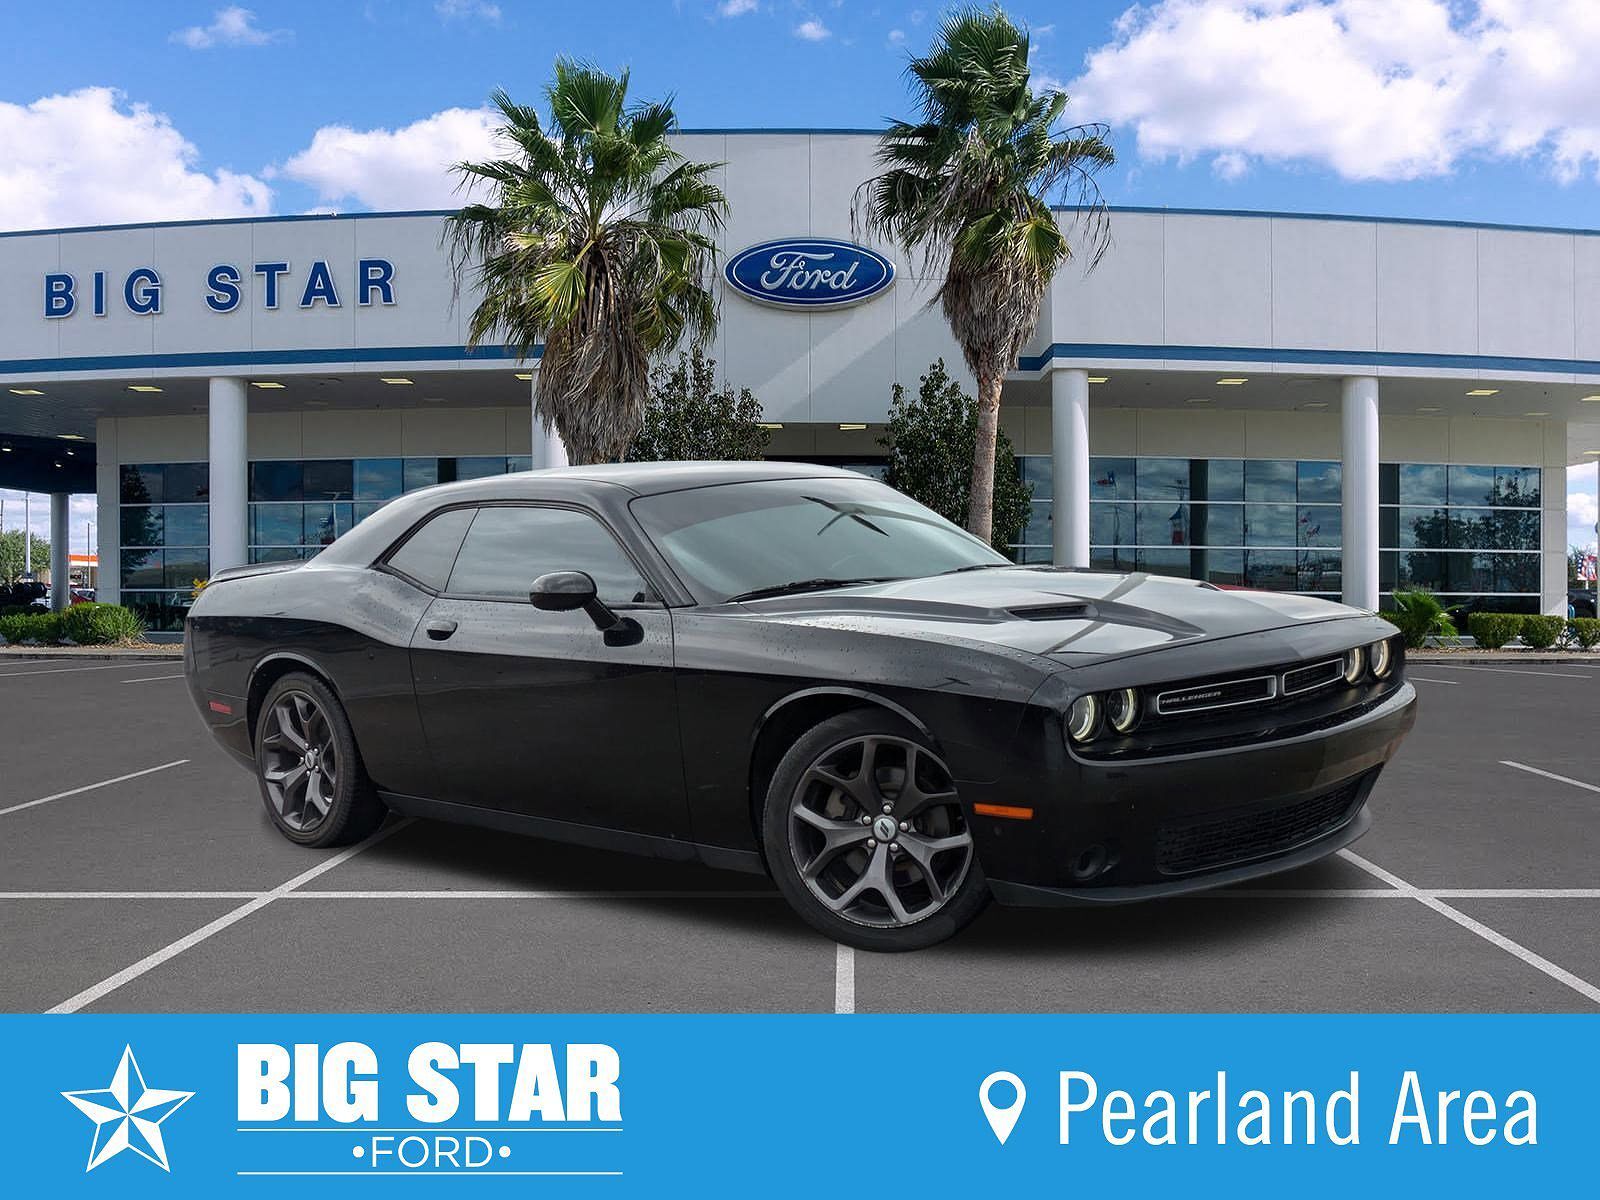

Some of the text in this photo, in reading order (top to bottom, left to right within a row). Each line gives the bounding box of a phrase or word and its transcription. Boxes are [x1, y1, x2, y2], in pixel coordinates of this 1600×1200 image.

[44, 258, 397, 319] BIG STAR
[760, 251, 860, 290] Ford
